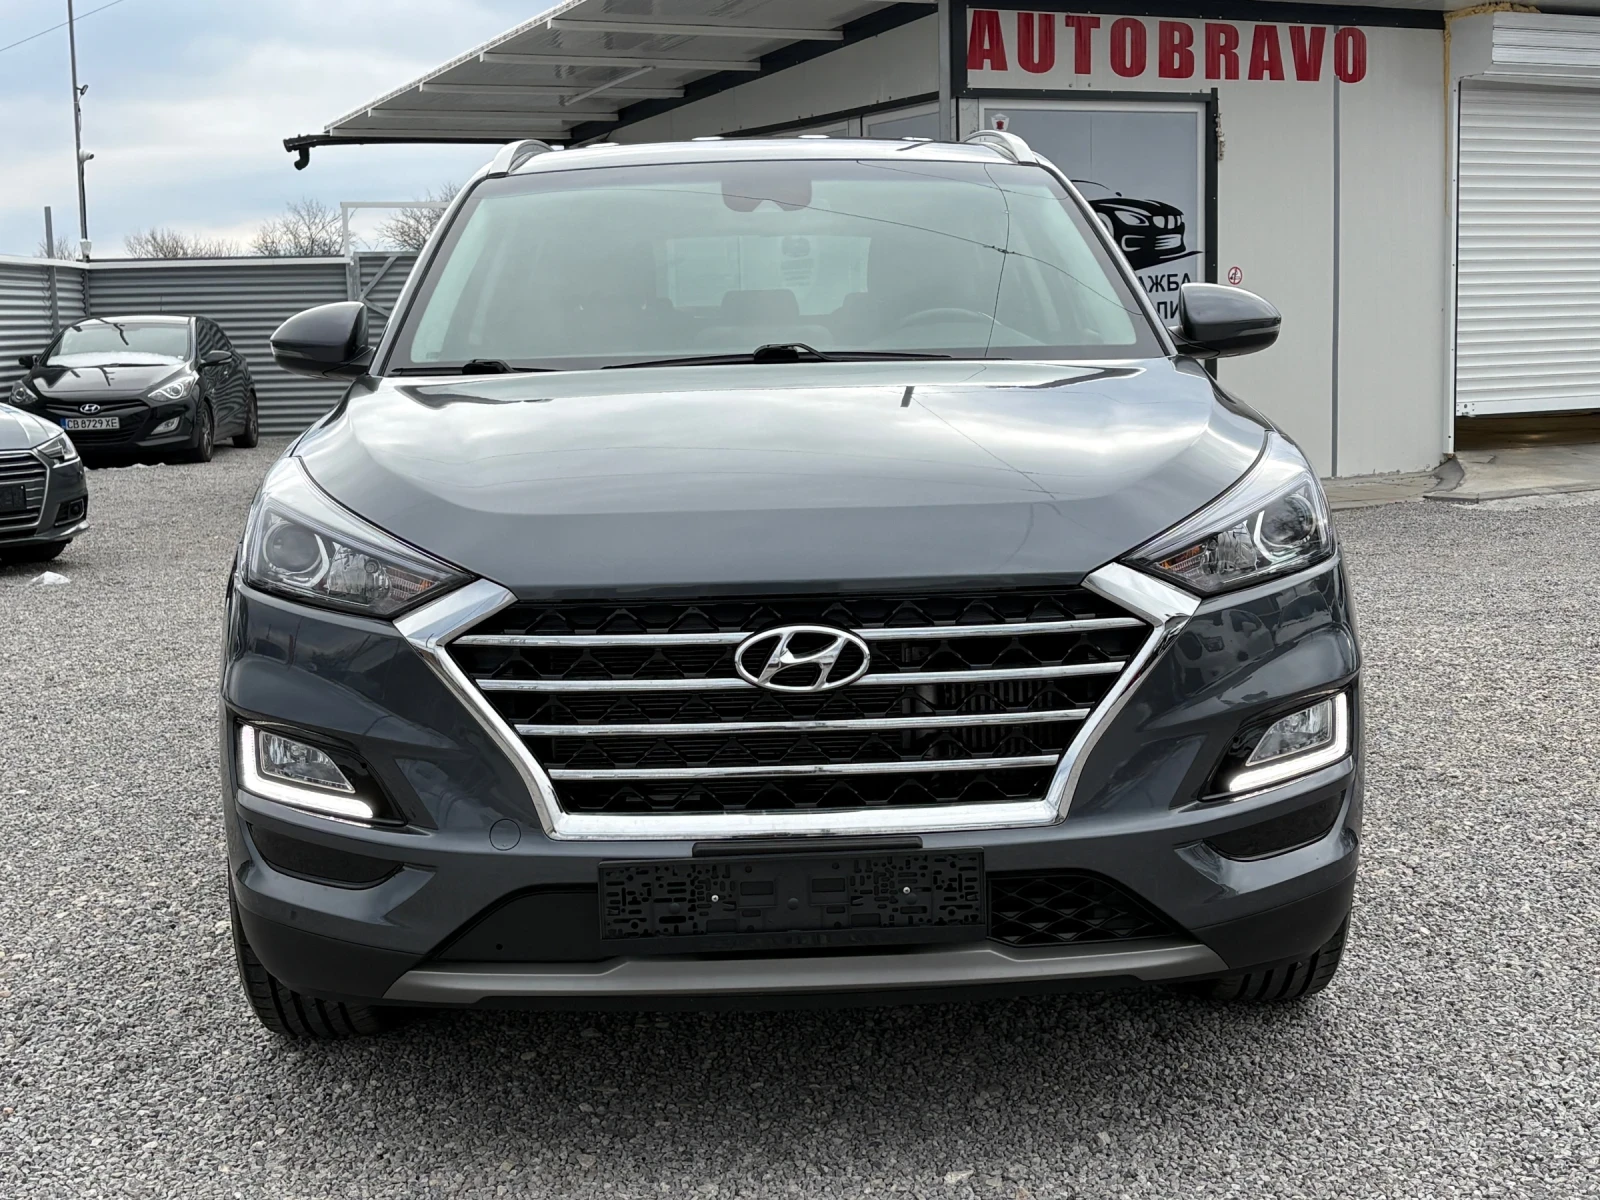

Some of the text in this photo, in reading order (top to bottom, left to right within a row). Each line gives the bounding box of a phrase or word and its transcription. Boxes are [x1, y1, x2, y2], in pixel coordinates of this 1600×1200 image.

[967, 10, 1367, 83] AUTOBRAVO
[67, 418, 117, 429] CB 8729 XE
